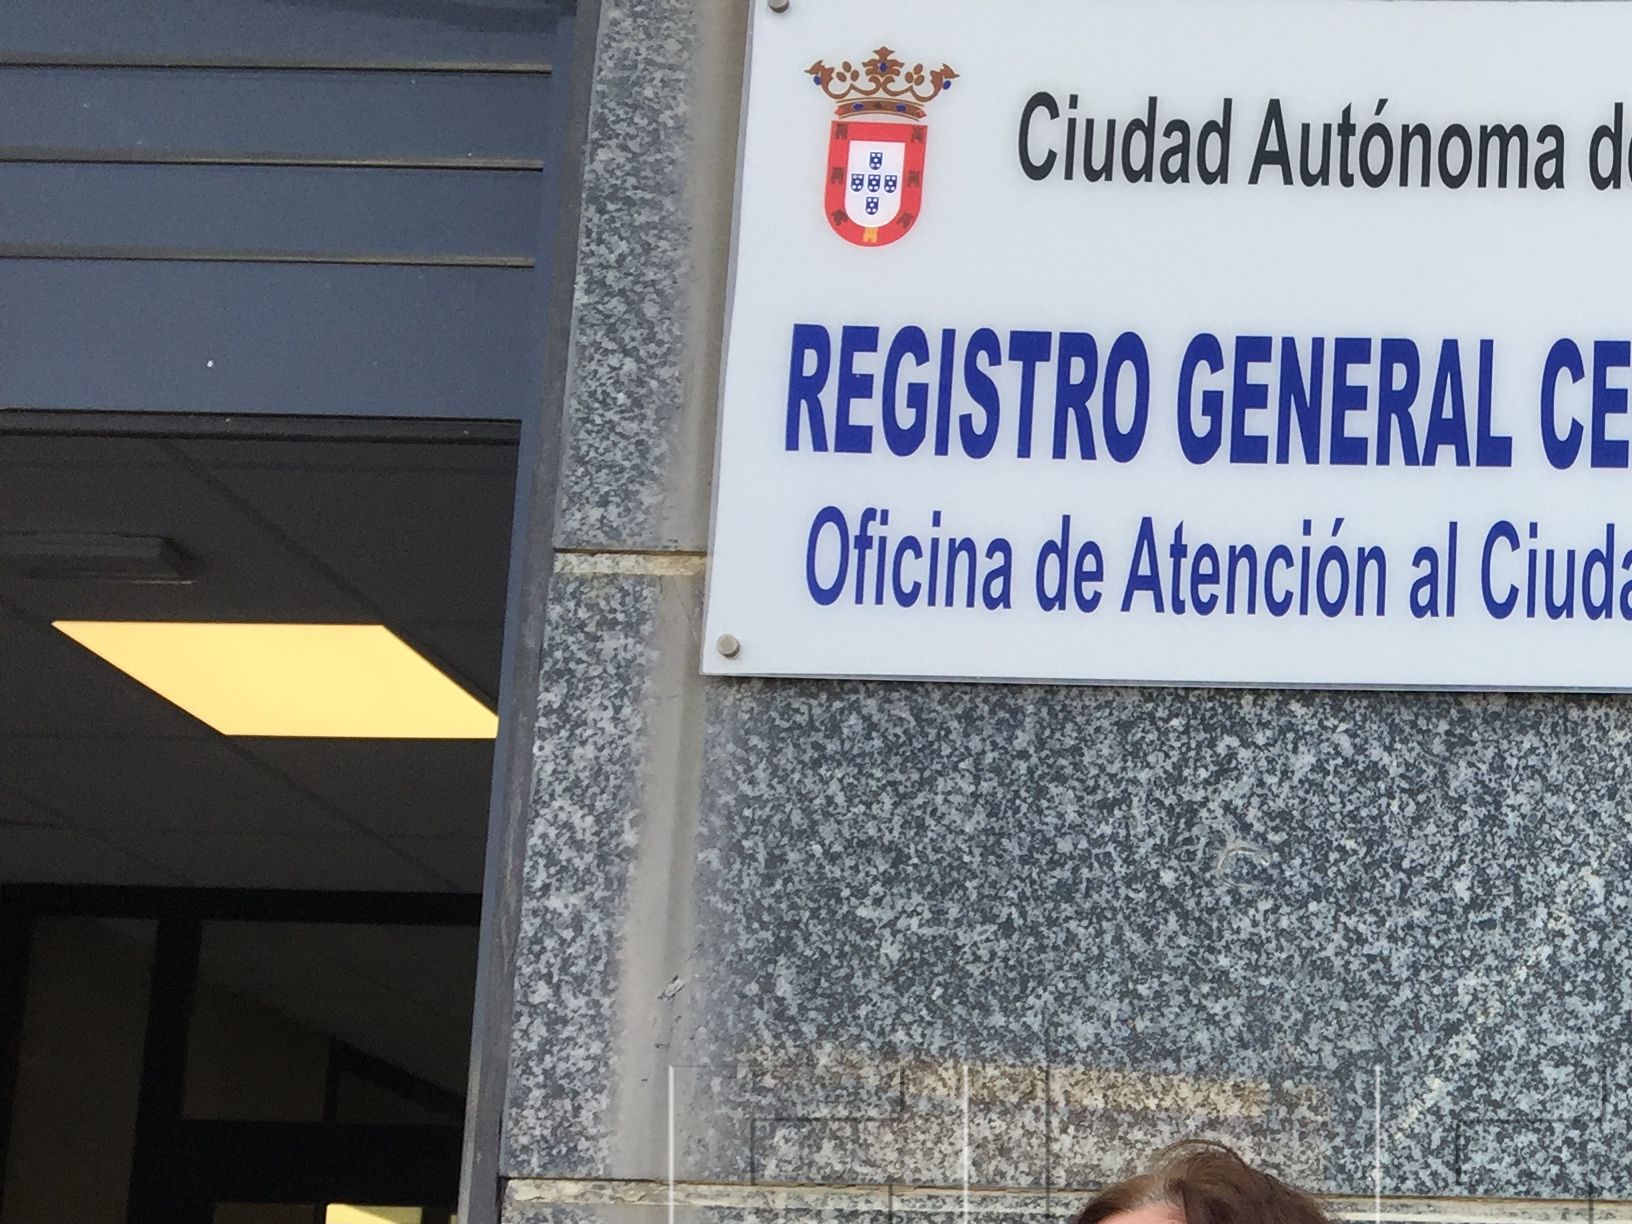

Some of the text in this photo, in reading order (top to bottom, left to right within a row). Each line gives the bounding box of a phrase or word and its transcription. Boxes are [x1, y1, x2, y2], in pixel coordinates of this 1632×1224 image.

[1019, 92, 1232, 185] Ciudad
[1248, 99, 1564, 190] Autónoma
[786, 324, 1150, 463] REGISTRO
[1177, 333, 1512, 467] GENERAL
[806, 506, 1012, 610] Oficina
[1036, 515, 1103, 613] de
[1121, 517, 1386, 617] Atención
[1410, 522, 1457, 618] al
